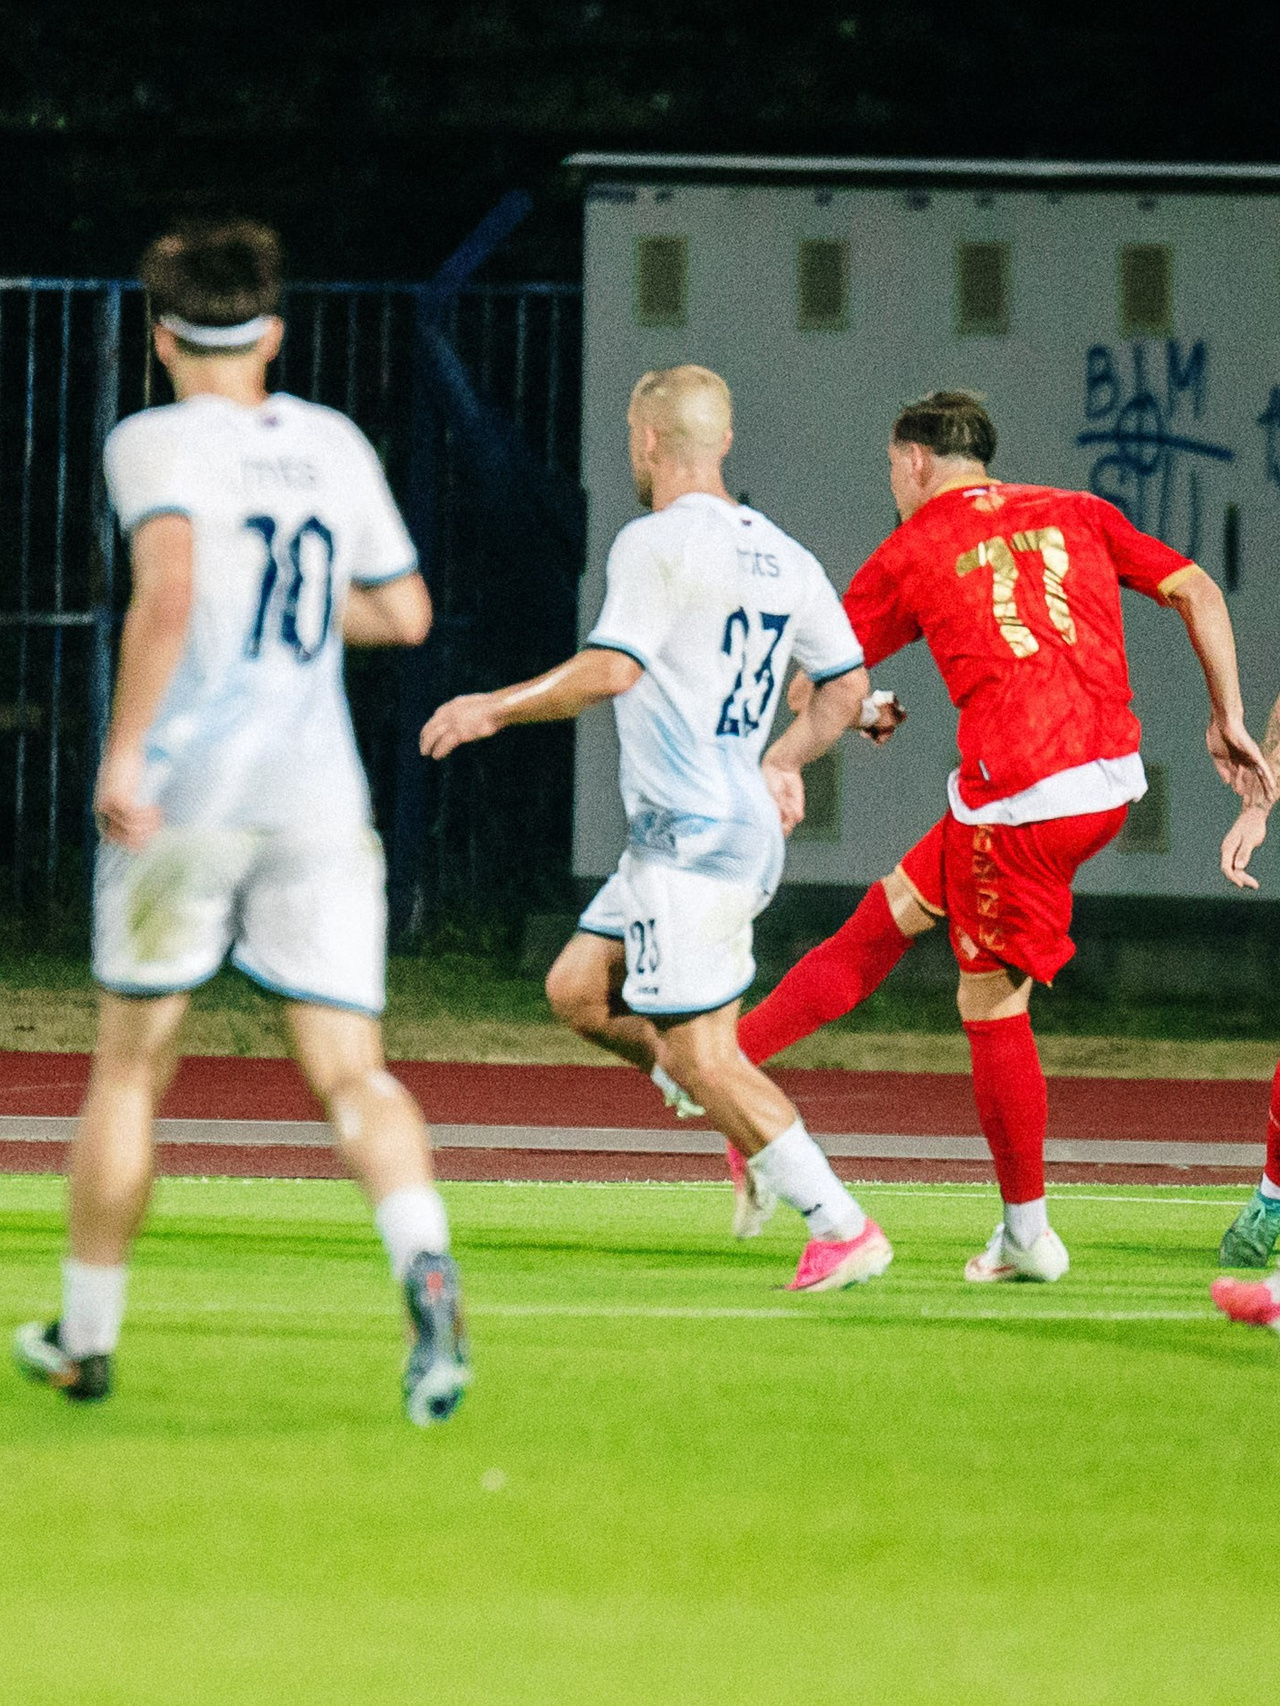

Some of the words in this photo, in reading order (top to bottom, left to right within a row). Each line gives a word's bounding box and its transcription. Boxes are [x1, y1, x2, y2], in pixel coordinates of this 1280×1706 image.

[242, 515, 334, 662] 10
[955, 526, 1078, 658] 77
[716, 606, 790, 737] 23
